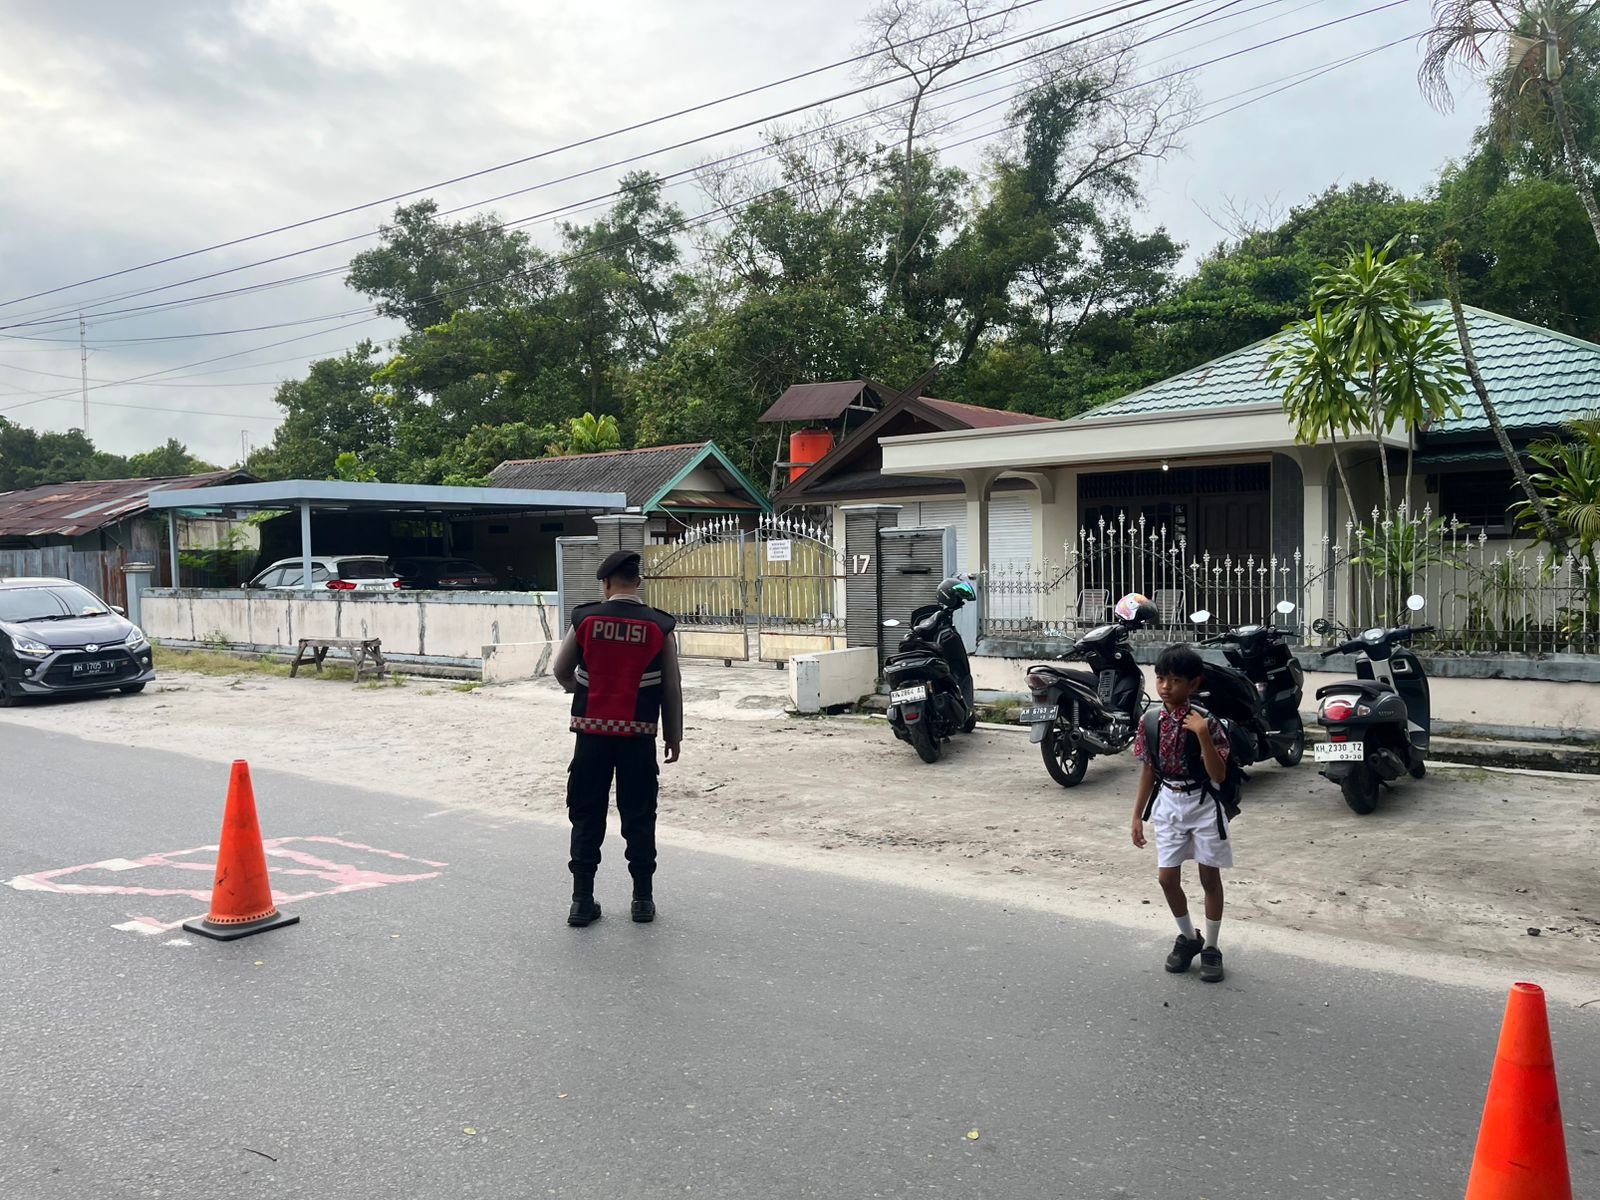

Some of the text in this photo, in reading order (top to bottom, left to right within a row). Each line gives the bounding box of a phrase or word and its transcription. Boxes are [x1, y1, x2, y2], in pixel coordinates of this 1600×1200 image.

[852, 554, 871, 574] 17
[592, 620, 647, 643] POLISI
[86, 661, 102, 670] 1705
[1315, 743, 1362, 753] KH 2330 TZ
